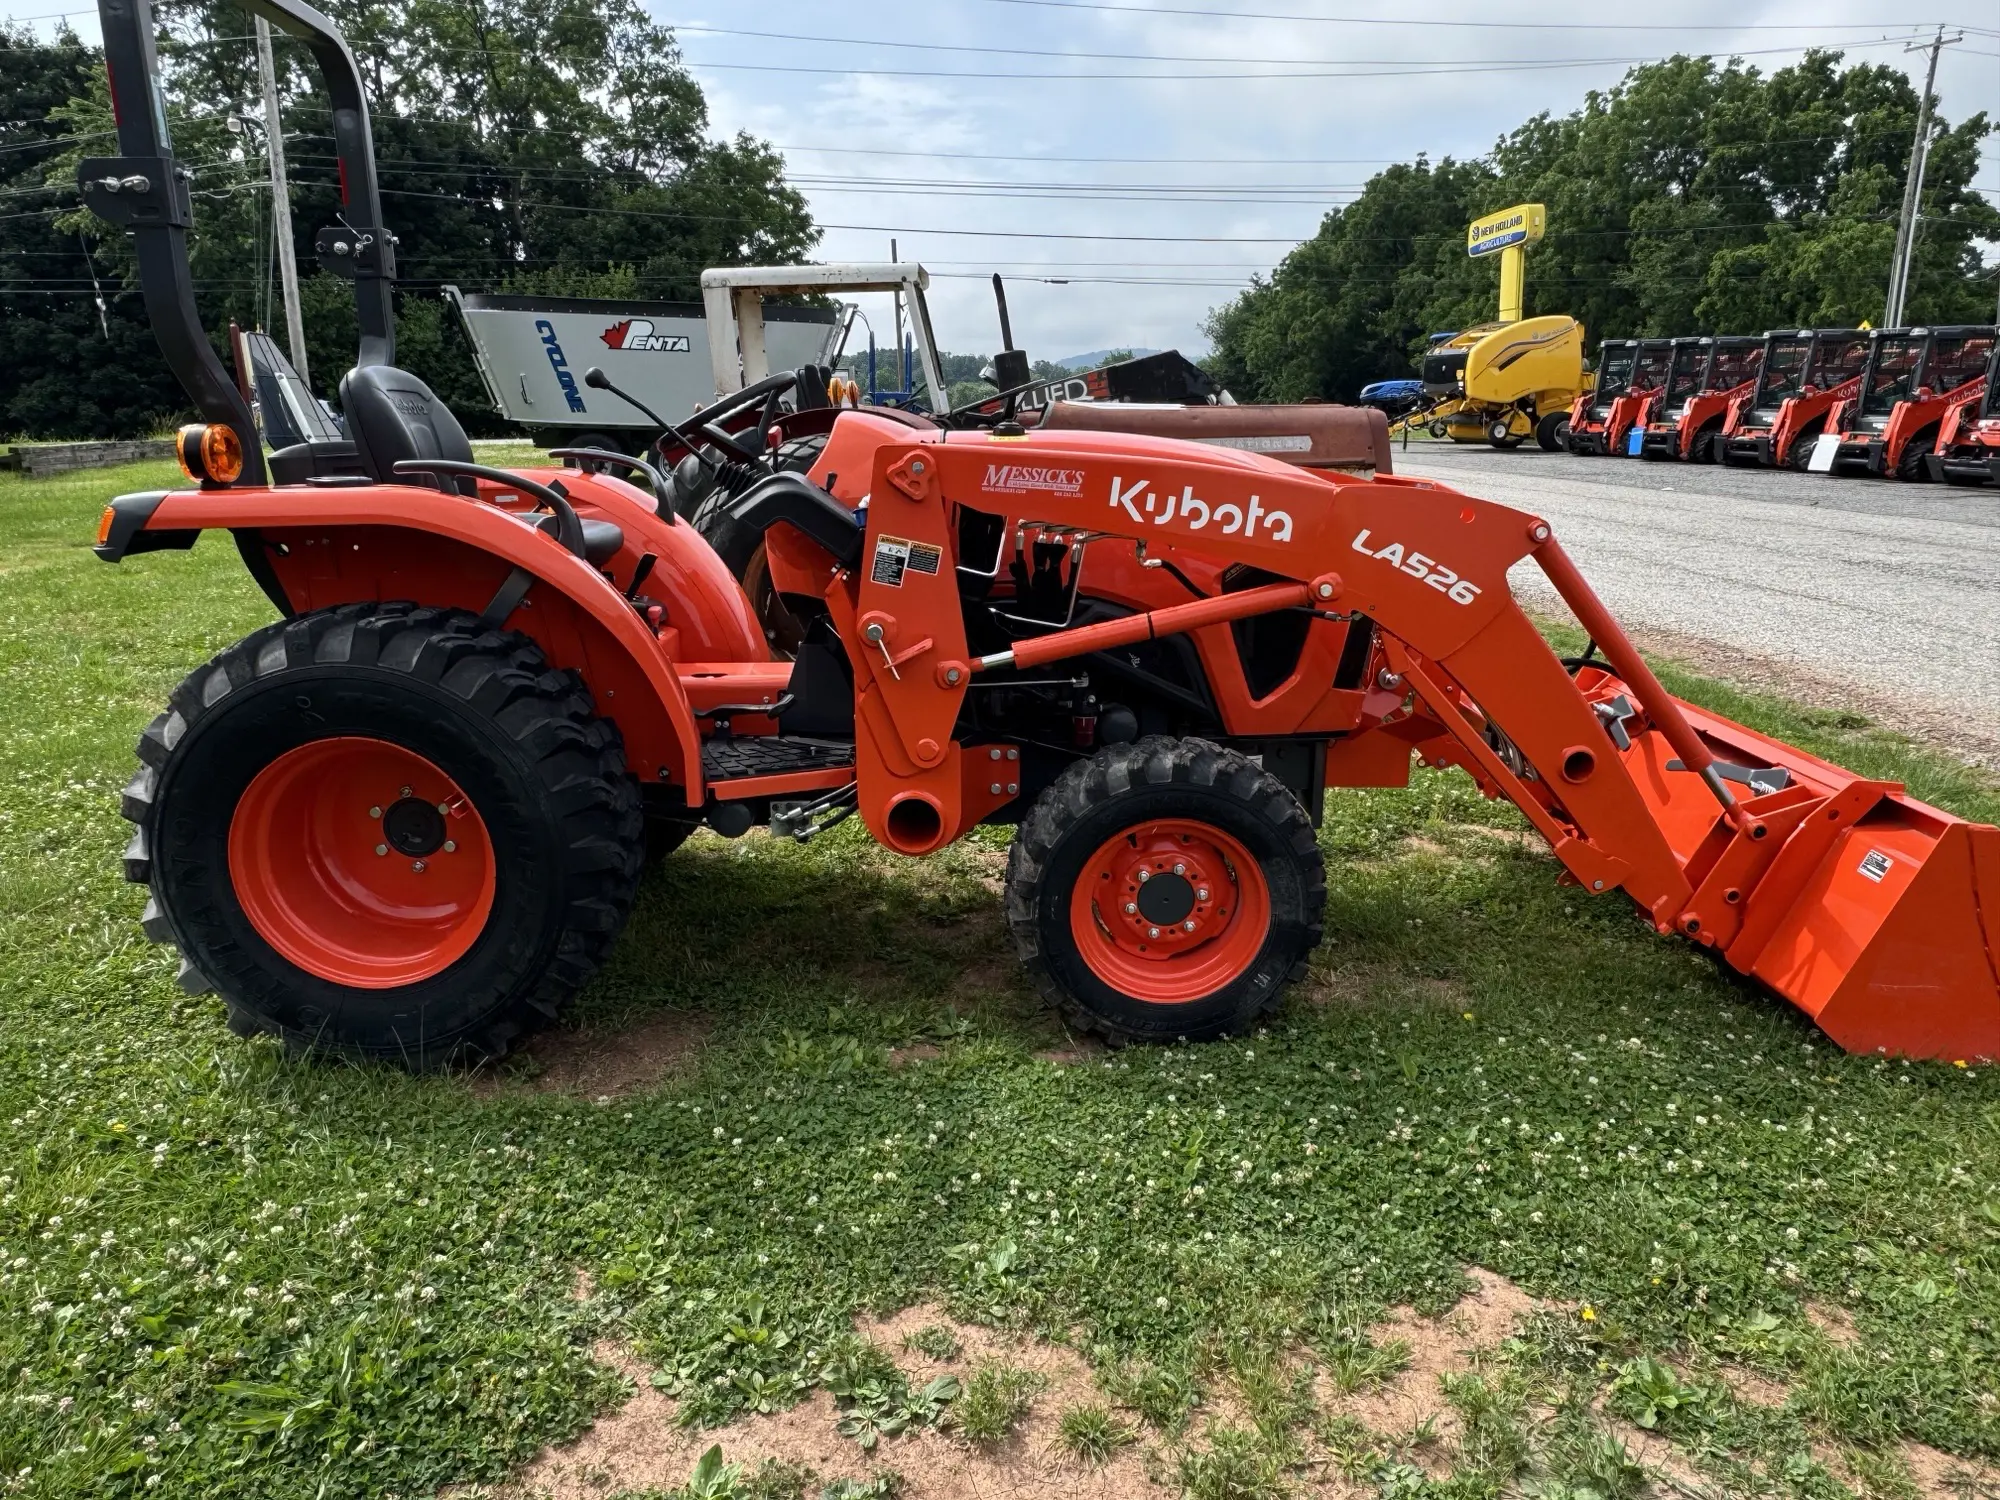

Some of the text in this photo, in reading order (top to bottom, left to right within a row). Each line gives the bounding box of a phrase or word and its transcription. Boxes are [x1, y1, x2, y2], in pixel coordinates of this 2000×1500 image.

[1481, 215, 1522, 237] NEW HOLLAND
[620, 319, 690, 352] PENTA
[535, 320, 587, 413] CYCLONE
[982, 464, 1085, 487] MESSICK'S
[1109, 476, 1293, 542] Kubota
[1351, 528, 1482, 605] LA526
